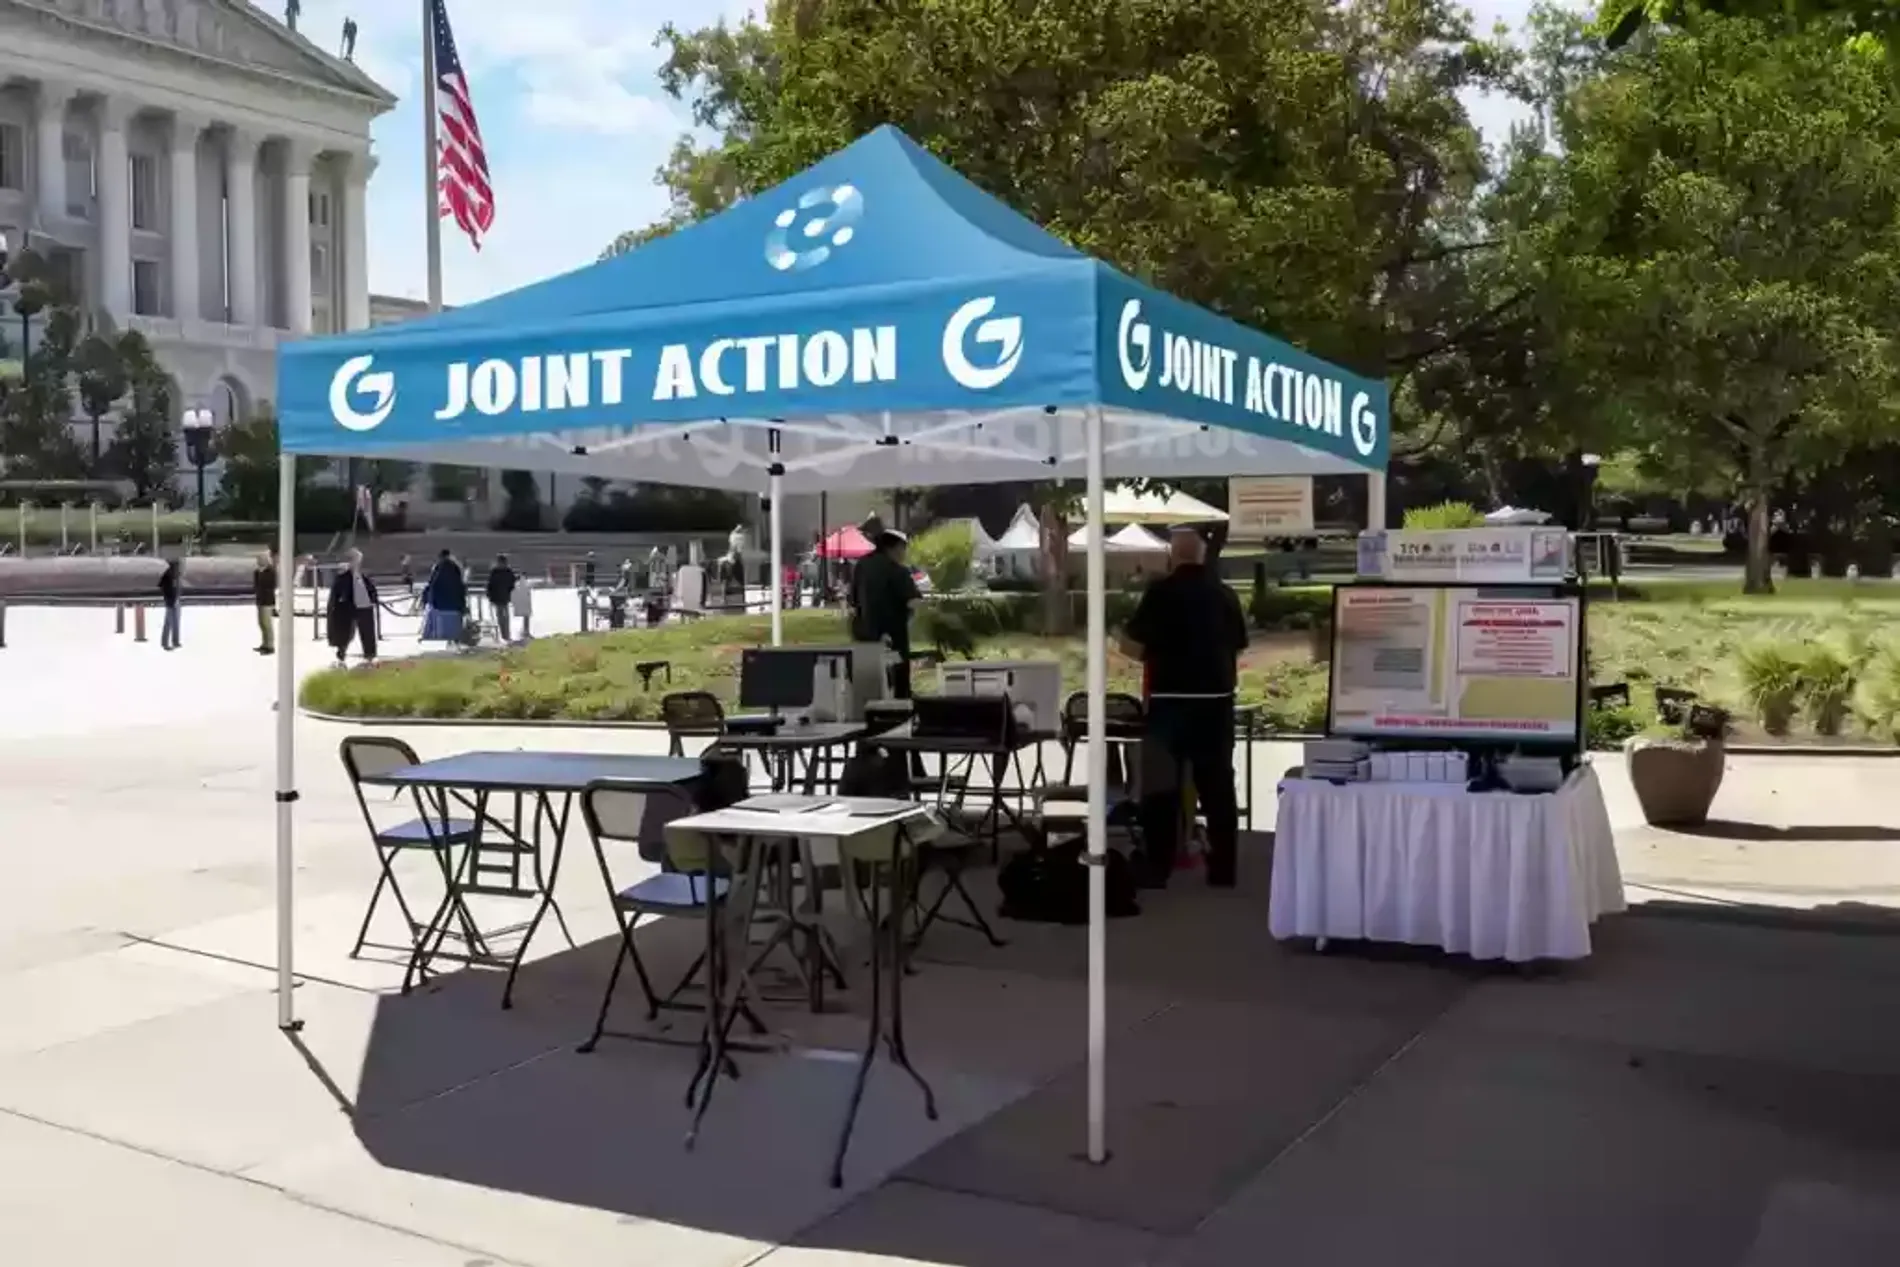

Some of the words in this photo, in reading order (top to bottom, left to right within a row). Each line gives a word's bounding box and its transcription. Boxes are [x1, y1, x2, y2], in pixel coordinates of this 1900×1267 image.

[433, 348, 632, 420] JOINT
[652, 325, 897, 401] ACTION
[1158, 331, 1238, 405] JOINT
[1245, 356, 1342, 437] ACTION
